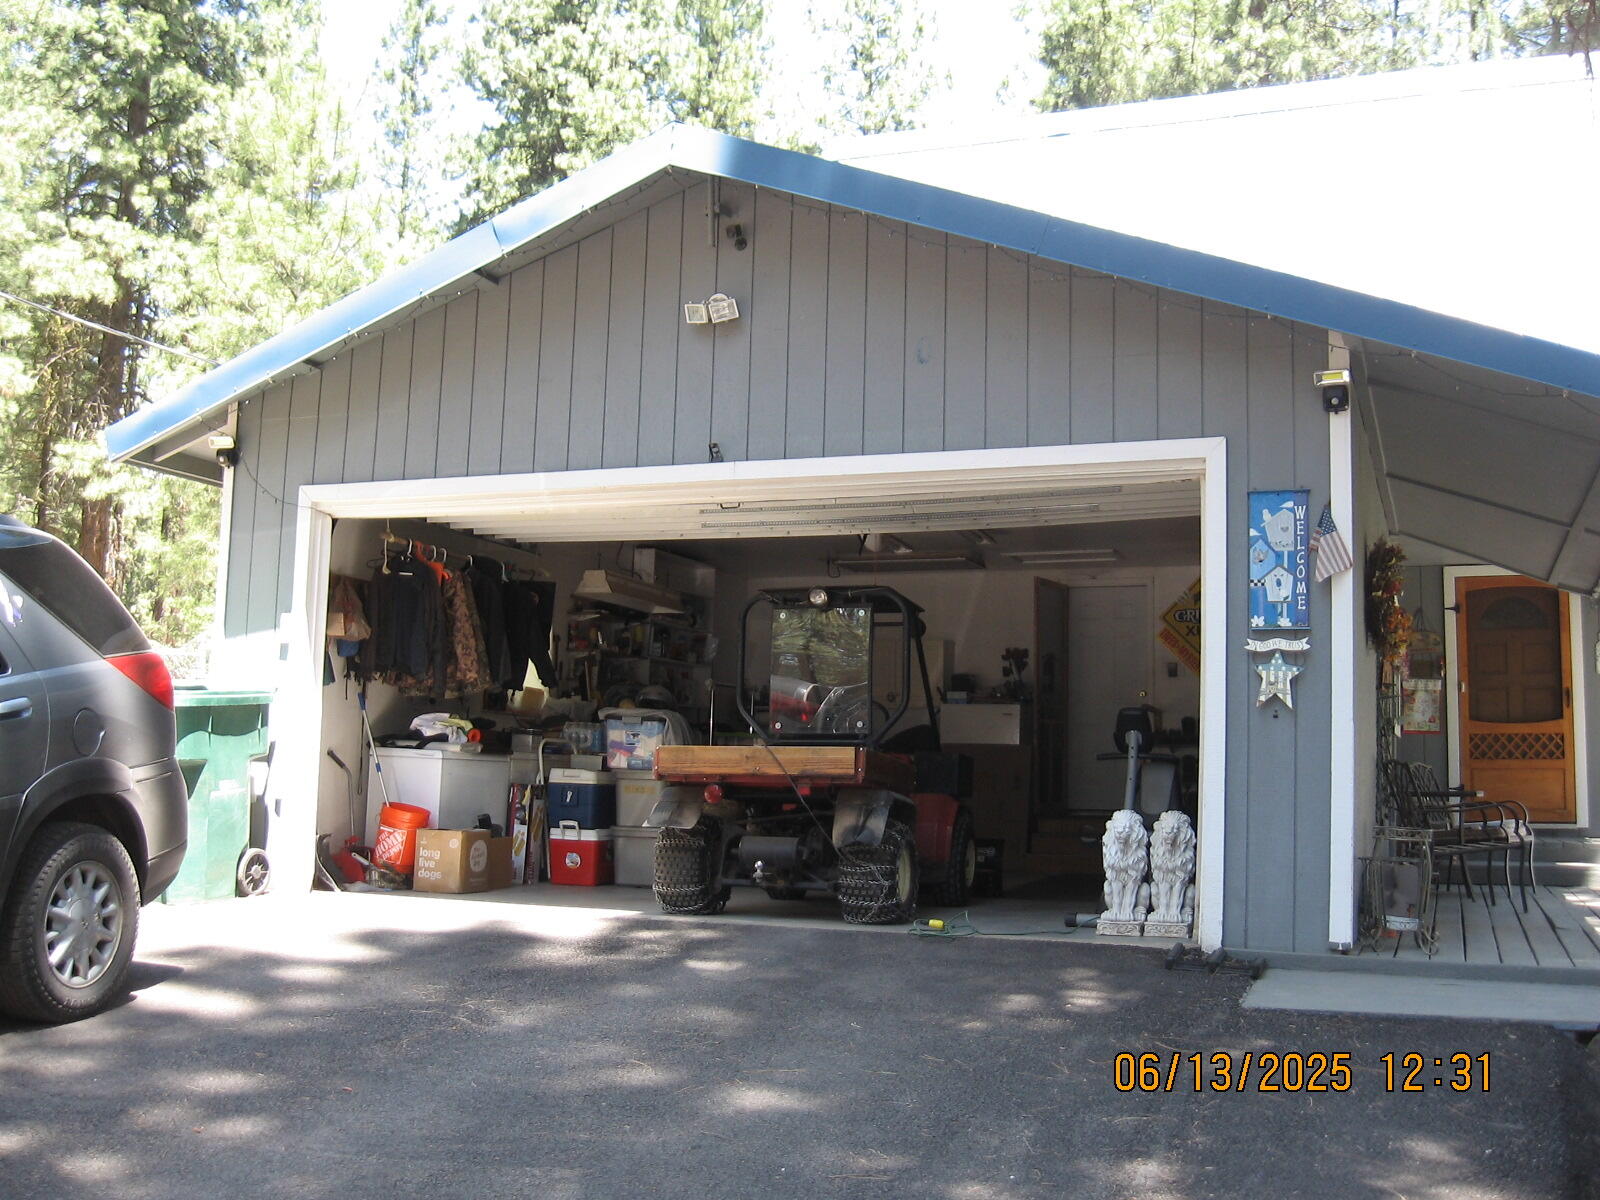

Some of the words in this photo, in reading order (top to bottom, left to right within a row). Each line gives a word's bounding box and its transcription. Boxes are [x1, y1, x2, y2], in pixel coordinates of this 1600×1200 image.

[1293, 504, 1307, 610] WELCOME
[375, 832, 404, 858] HOME
[419, 847, 440, 859] long
[419, 858, 435, 867] live
[418, 868, 441, 879] dogs
